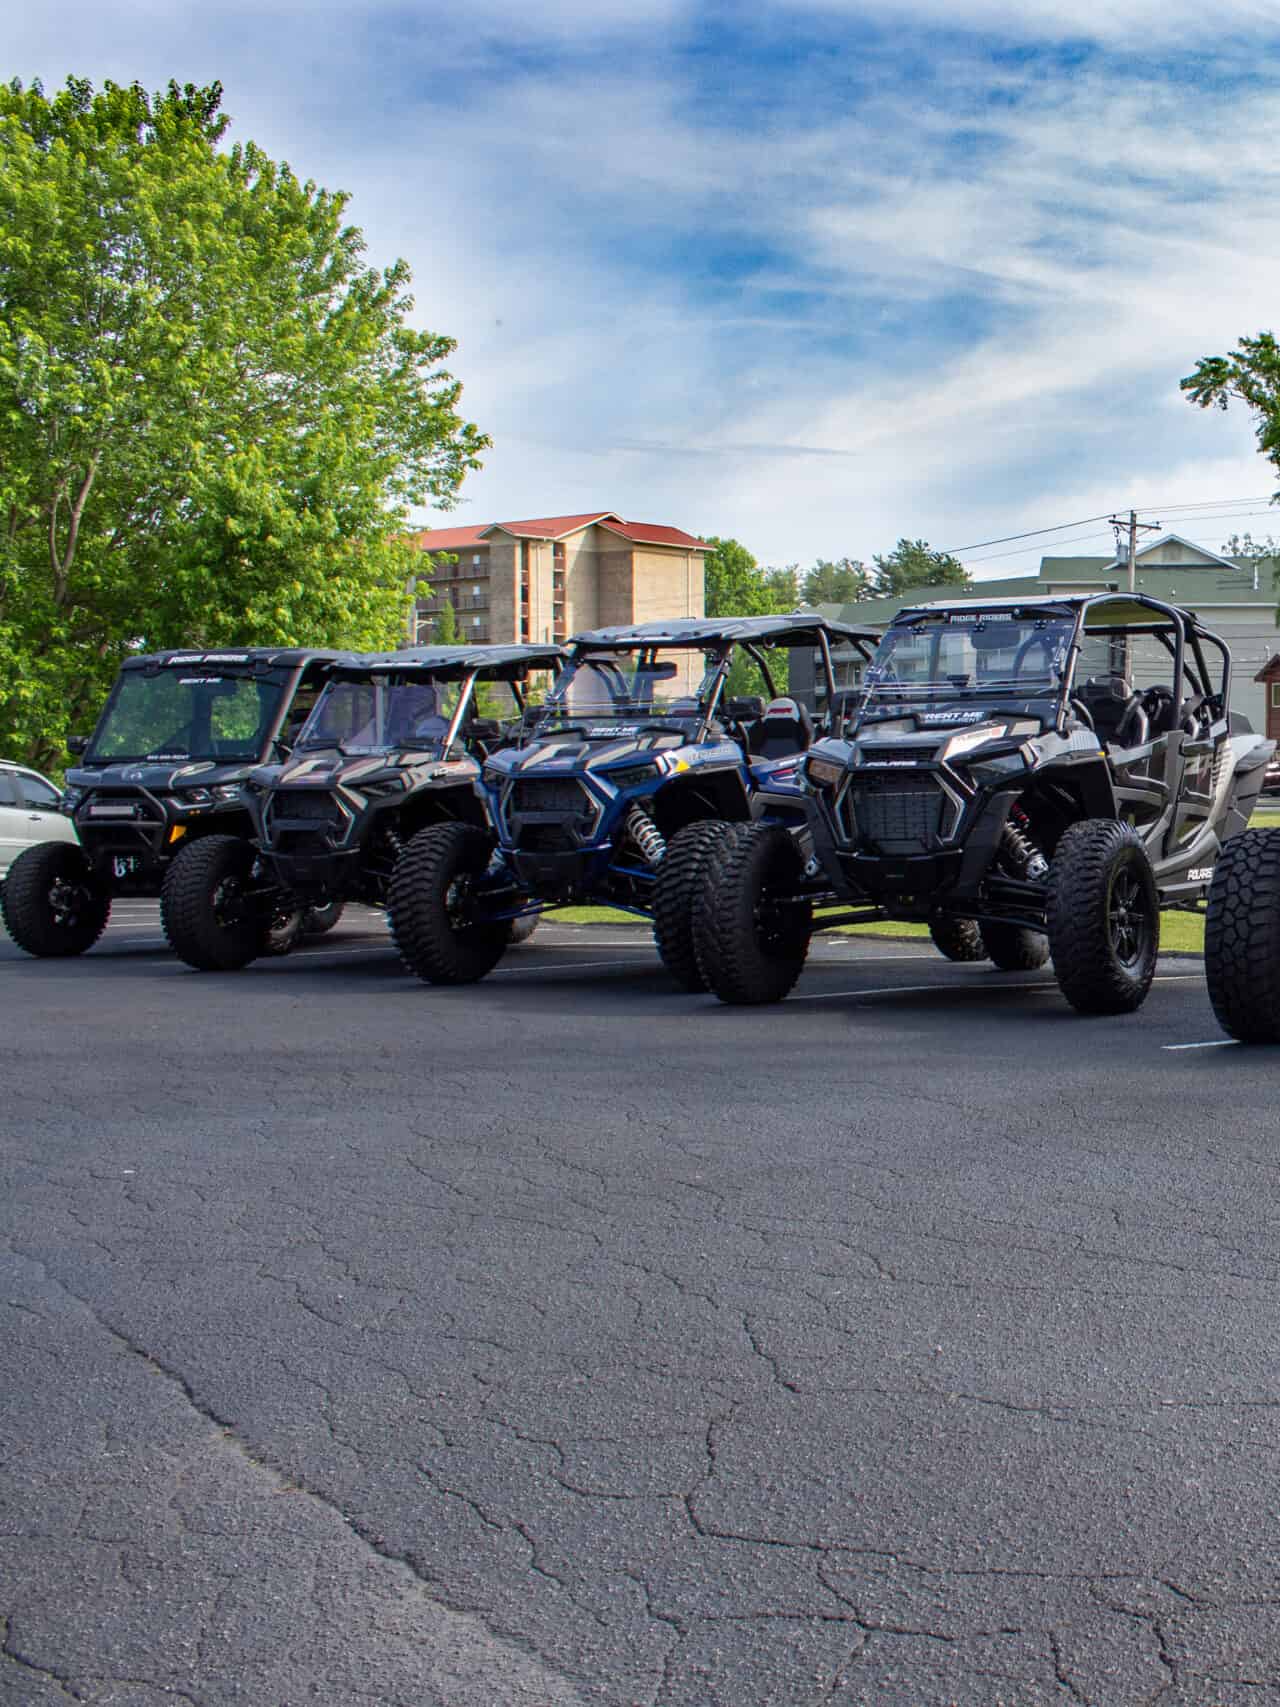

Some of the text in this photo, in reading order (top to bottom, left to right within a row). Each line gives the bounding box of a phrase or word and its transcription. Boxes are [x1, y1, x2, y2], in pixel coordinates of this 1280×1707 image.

[950, 613, 1012, 623] RIDGE RIDERS
[924, 711, 985, 720] RENT ME
